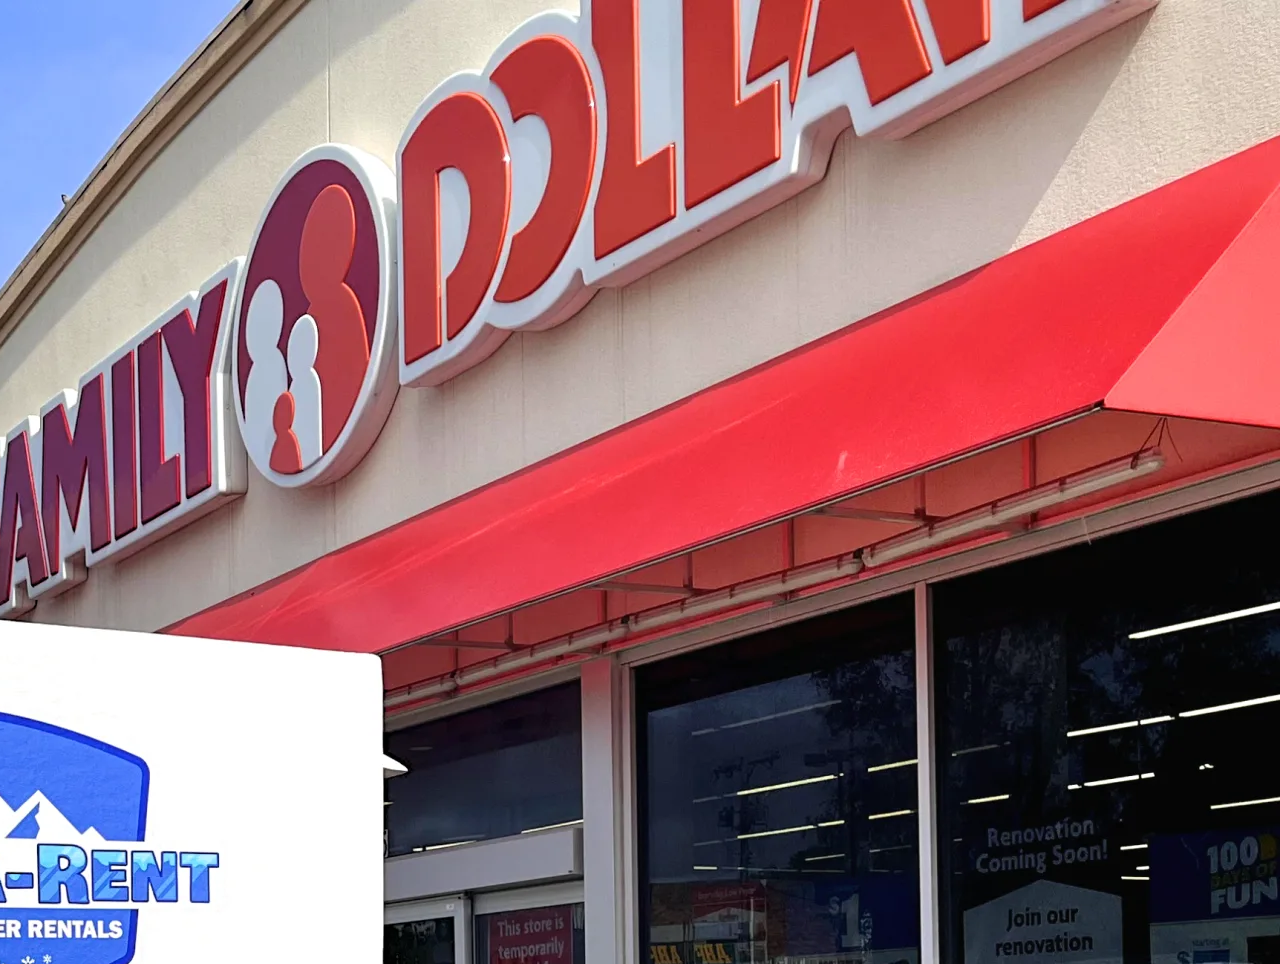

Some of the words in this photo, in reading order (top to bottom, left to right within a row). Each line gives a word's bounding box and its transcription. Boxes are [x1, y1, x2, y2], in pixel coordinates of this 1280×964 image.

[401, 0, 1066, 366] DOLL
[987, 817, 1094, 848] Renovation
[976, 849, 1047, 873] Coming
[1052, 839, 1108, 866] Soon!
[1207, 836, 1259, 874] 100
[1210, 876, 1279, 915] FUN
[28, 919, 123, 939] RENTALS
[497, 920, 521, 937] This
[524, 918, 552, 935] store
[554, 914, 564, 931] is
[1006, 907, 1042, 932] Join
[1047, 908, 1079, 924] our
[498, 938, 565, 961] temporarily
[995, 931, 1094, 957] renovation
